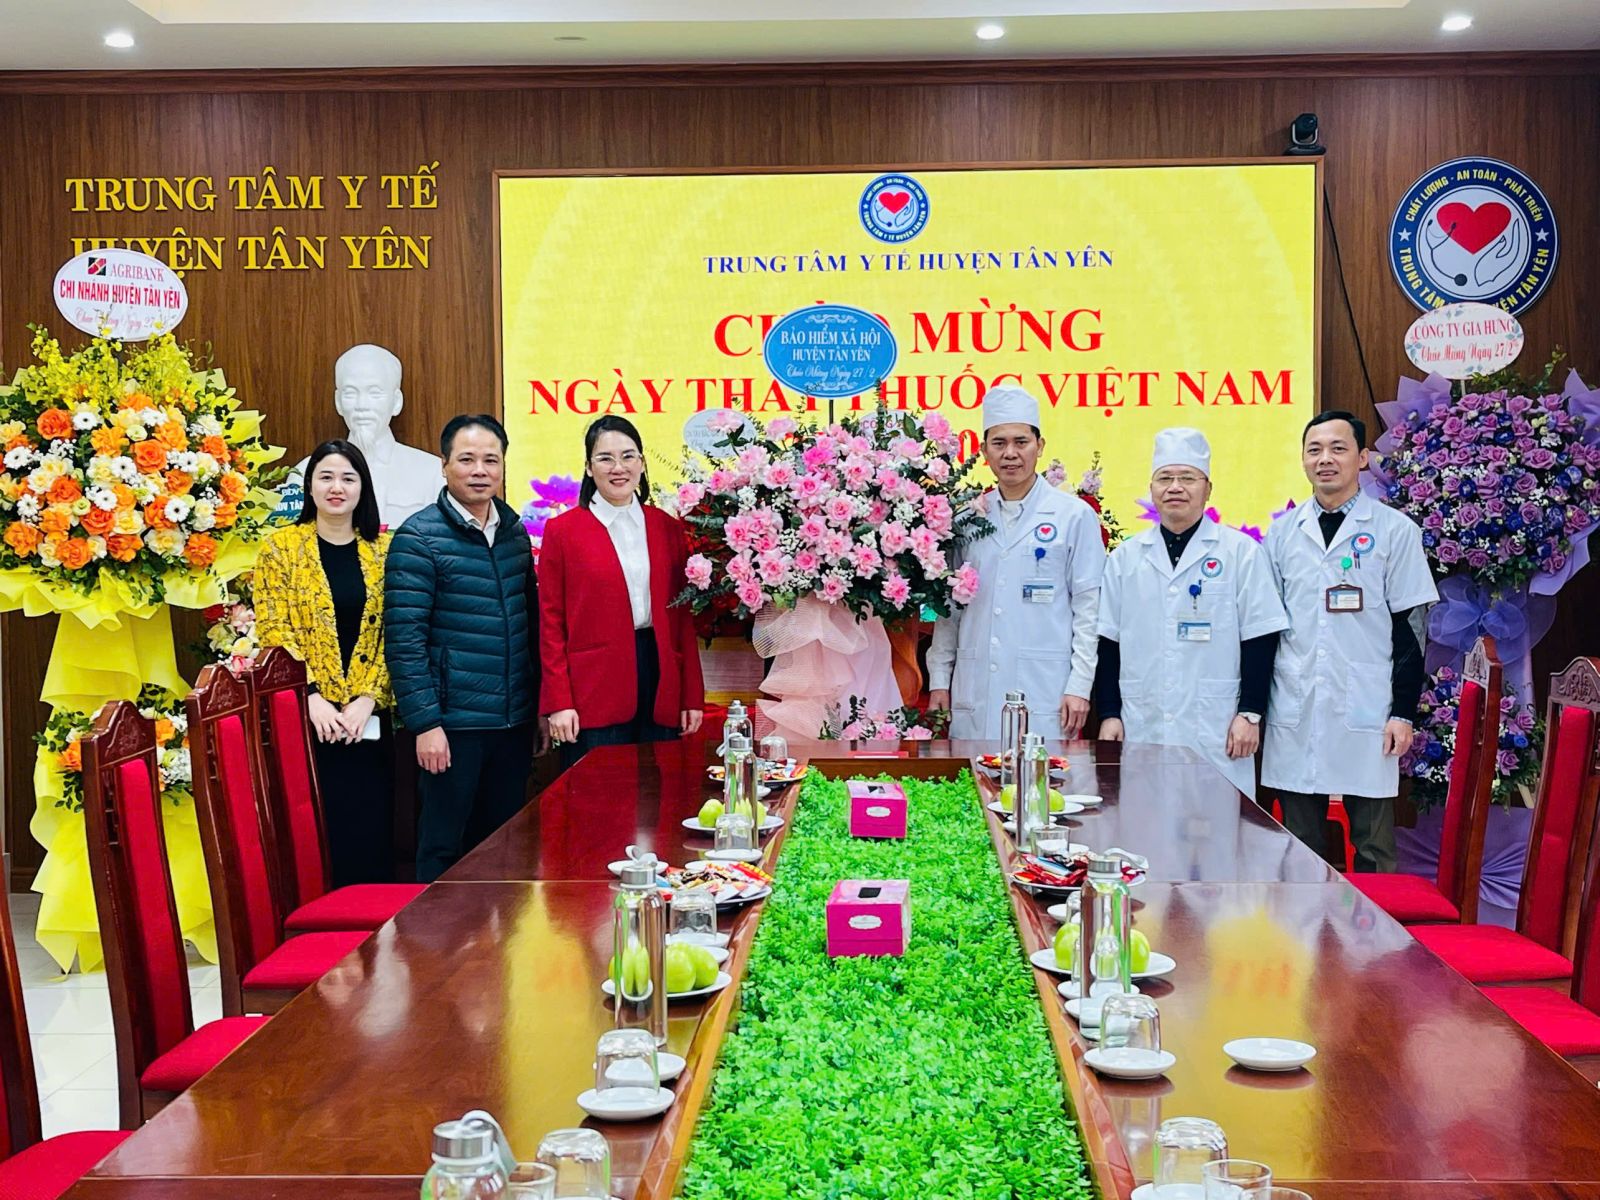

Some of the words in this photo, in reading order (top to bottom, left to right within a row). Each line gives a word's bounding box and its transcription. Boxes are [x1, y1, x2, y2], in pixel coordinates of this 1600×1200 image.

[65, 177, 217, 212] TRUNG
[229, 166, 324, 211] TÂM
[337, 175, 368, 210] Y
[381, 161, 440, 209] TẾ
[1457, 169, 1470, 181] AN
[238, 226, 328, 271] TÂN
[340, 225, 432, 270] YÊN
[703, 254, 787, 274] TRUNG
[793, 250, 847, 272] TÂM
[860, 254, 876, 272] Y
[881, 248, 911, 271] TẾ
[919, 249, 1002, 275] HUYỆN
[1009, 245, 1058, 269] TÂN
[1065, 244, 1115, 268] YÊN
[110, 263, 164, 282] AGRIBANK
[1400, 247, 1423, 290] TRUNG
[60, 279, 75, 299] CHI
[78, 279, 109, 302] NHÁNH
[112, 283, 141, 309] HUYỆN
[144, 285, 160, 307] TÂN
[163, 287, 180, 309] YÊN
[781, 326, 805, 345] BẢO
[808, 324, 838, 345] HIỂM
[841, 328, 857, 345] XÃ
[860, 327, 880, 349] HỘI
[910, 297, 1105, 354] MỪNG
[1447, 322, 1460, 338] TY
[1462, 320, 1482, 336] GIA
[792, 346, 826, 363] HUYỆN
[828, 345, 849, 360] TÂN
[851, 346, 871, 361] YÊN
[529, 368, 672, 415] NGÀY
[1038, 367, 1160, 418] VIỆT
[1175, 369, 1295, 406] NAM
